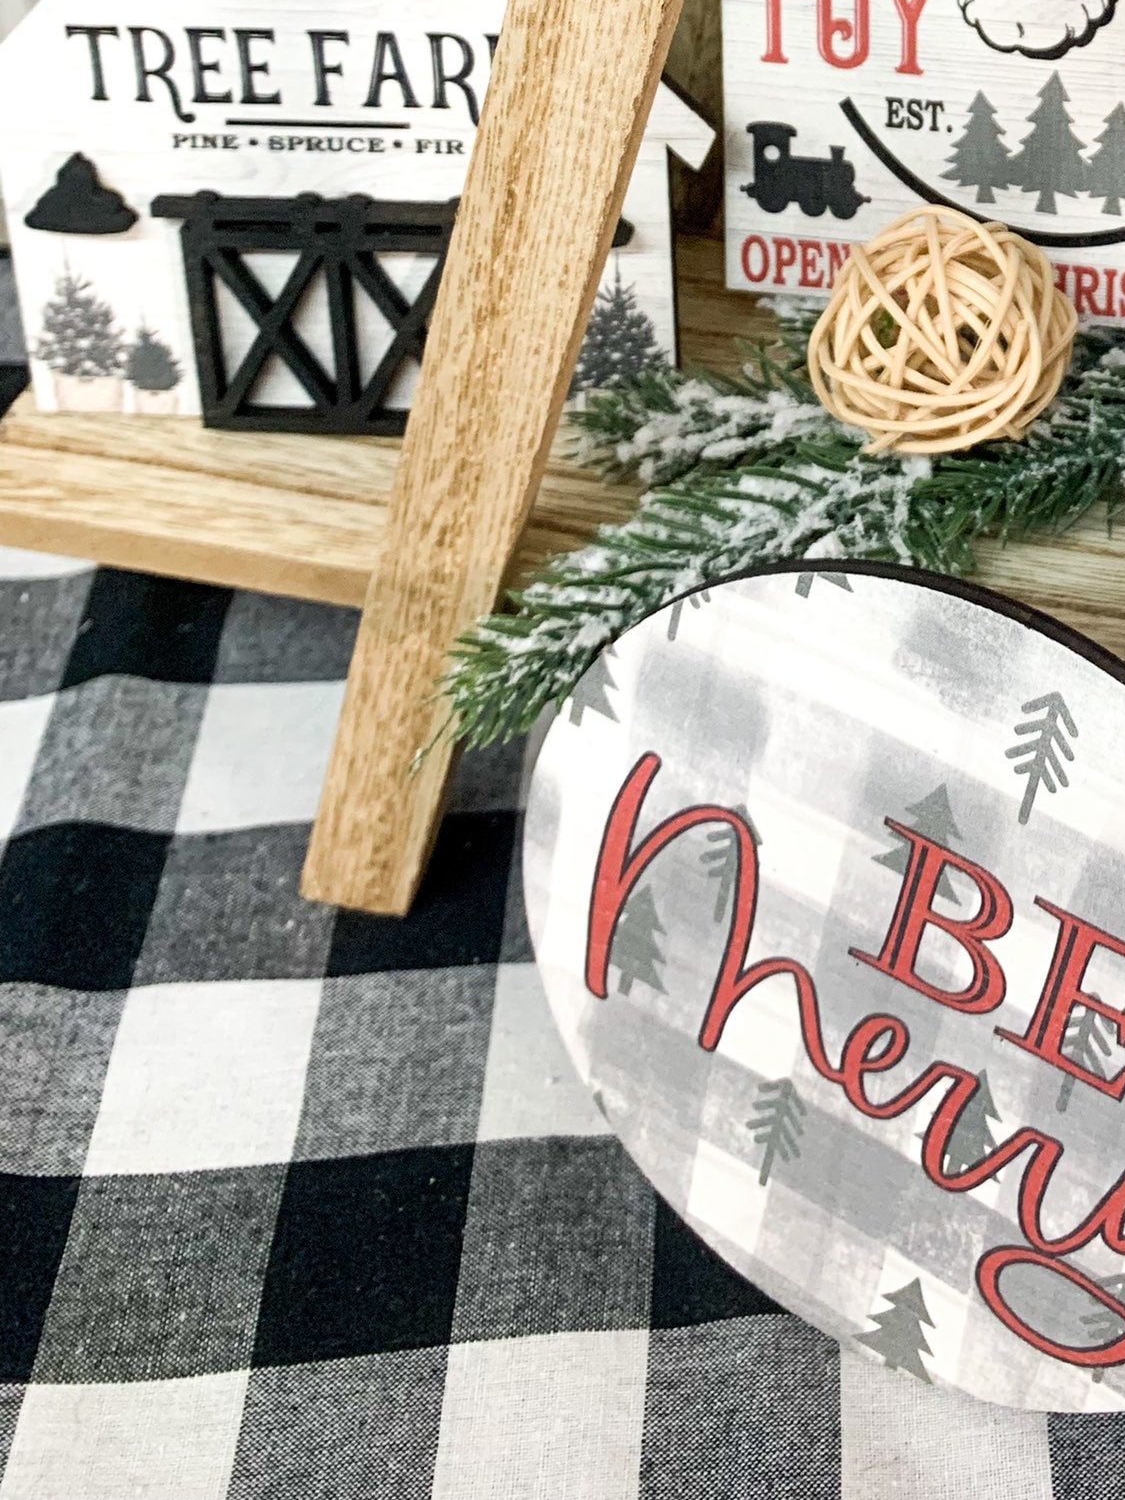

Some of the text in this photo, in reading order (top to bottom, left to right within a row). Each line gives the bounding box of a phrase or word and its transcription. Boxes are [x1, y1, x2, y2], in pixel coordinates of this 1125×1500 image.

[65, 24, 500, 128] TREE FAR
[884, 97, 954, 134] EST.
[171, 132, 467, 156] PINE SPRUCE FIR
